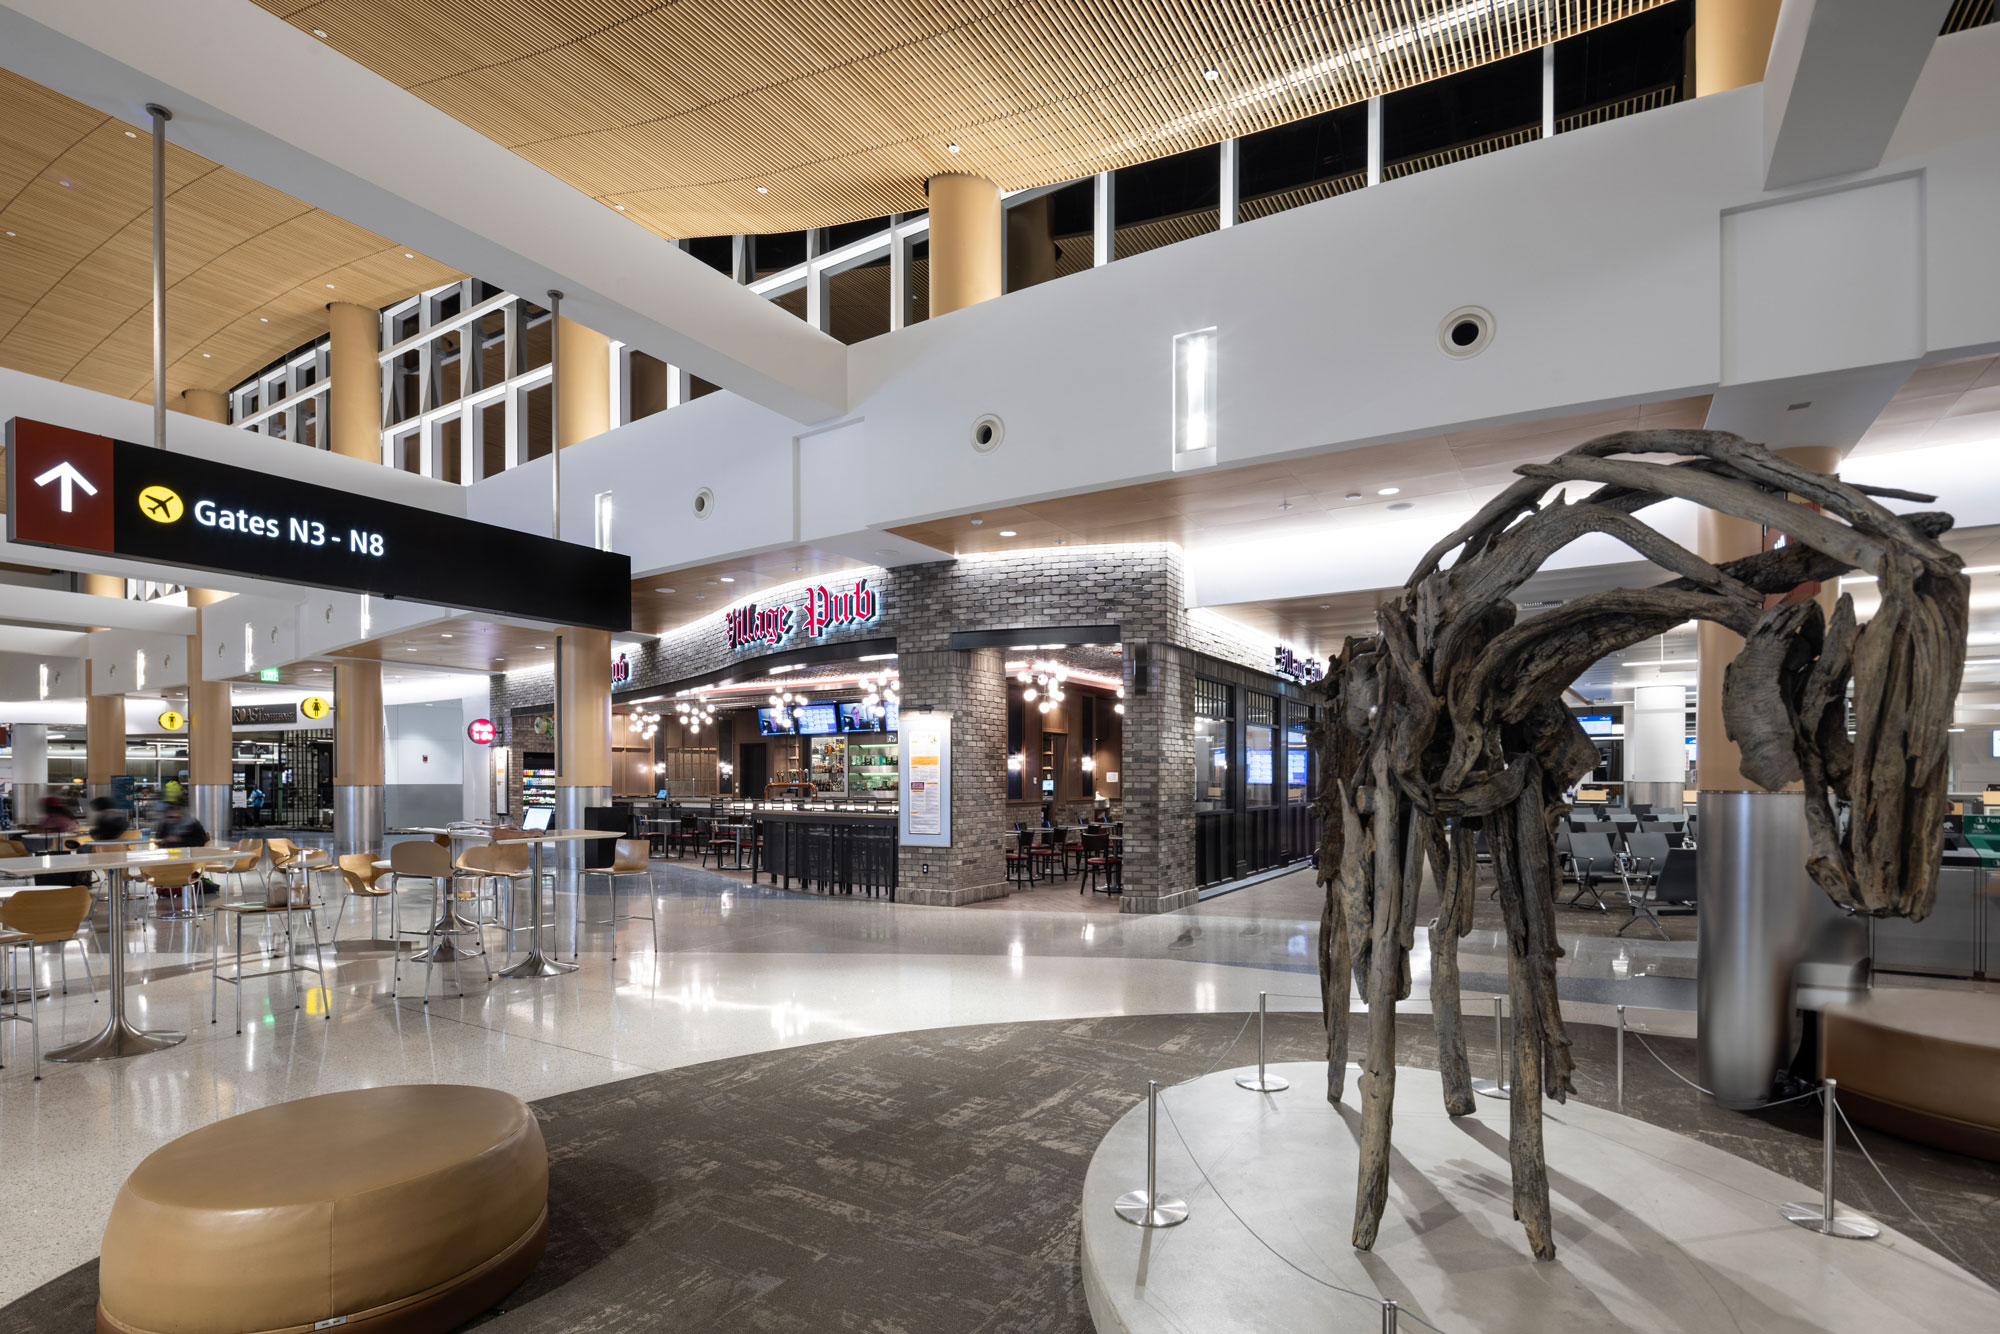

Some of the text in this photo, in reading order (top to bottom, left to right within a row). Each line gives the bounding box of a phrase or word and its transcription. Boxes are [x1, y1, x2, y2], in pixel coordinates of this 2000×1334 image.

[194, 500, 280, 538] Gates
[289, 517, 326, 546] N3
[350, 529, 385, 557] N8
[726, 579, 874, 649] Village Pub
[611, 653, 629, 682] ub
[233, 707, 264, 723] ROAST
[1986, 816, 2000, 824] Foo
